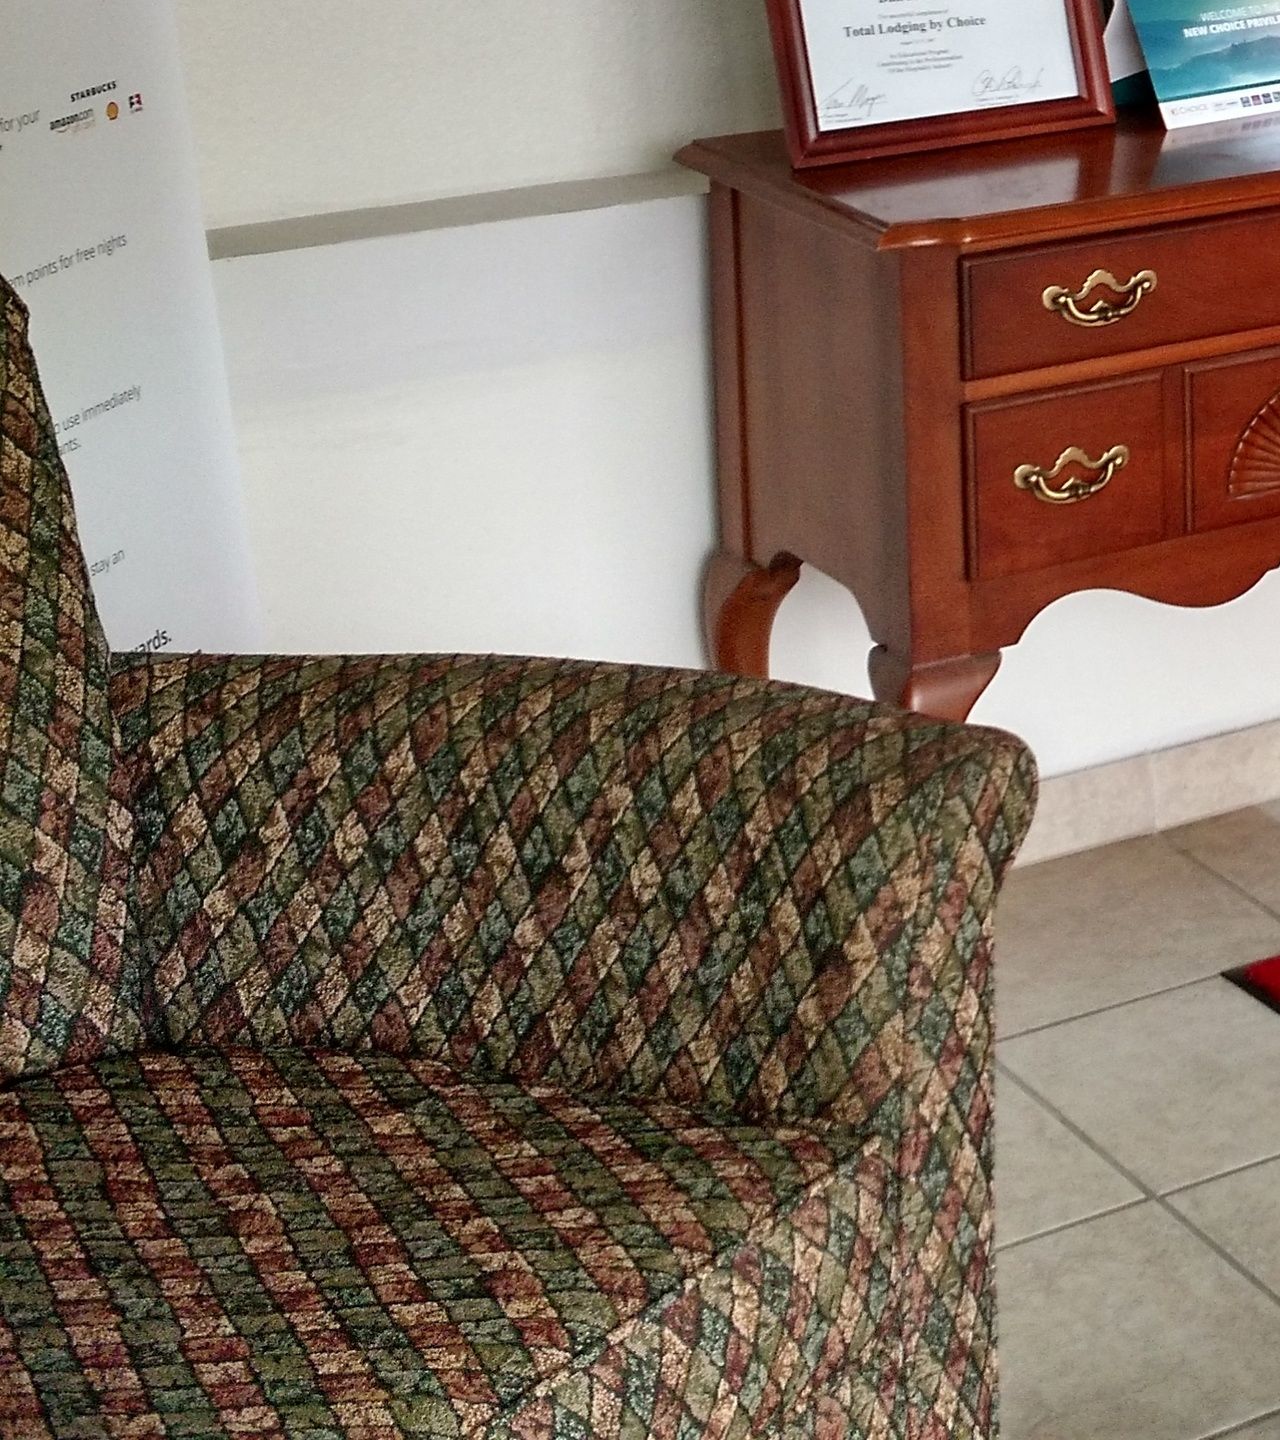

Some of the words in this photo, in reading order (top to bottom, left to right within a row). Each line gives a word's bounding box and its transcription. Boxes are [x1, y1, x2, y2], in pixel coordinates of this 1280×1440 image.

[1200, 6, 1248, 22] WELCOME
[1248, 4, 1263, 17] TO
[843, 25, 875, 39] Total
[879, 20, 927, 36] Lodging
[929, 19, 943, 32] by
[946, 15, 986, 29] Choice
[1183, 26, 1208, 39] NEW
[1209, 21, 1248, 34] CHOICE
[70, 80, 118, 103] STARBUCKS
[16, 110, 40, 133] your
[26, 261, 59, 288] points
[59, 254, 75, 271] for
[75, 247, 96, 264] free
[97, 234, 128, 257] nights
[62, 413, 81, 431] use
[81, 385, 141, 422] immediately
[90, 557, 110, 577] stay
[112, 549, 126, 566] an
